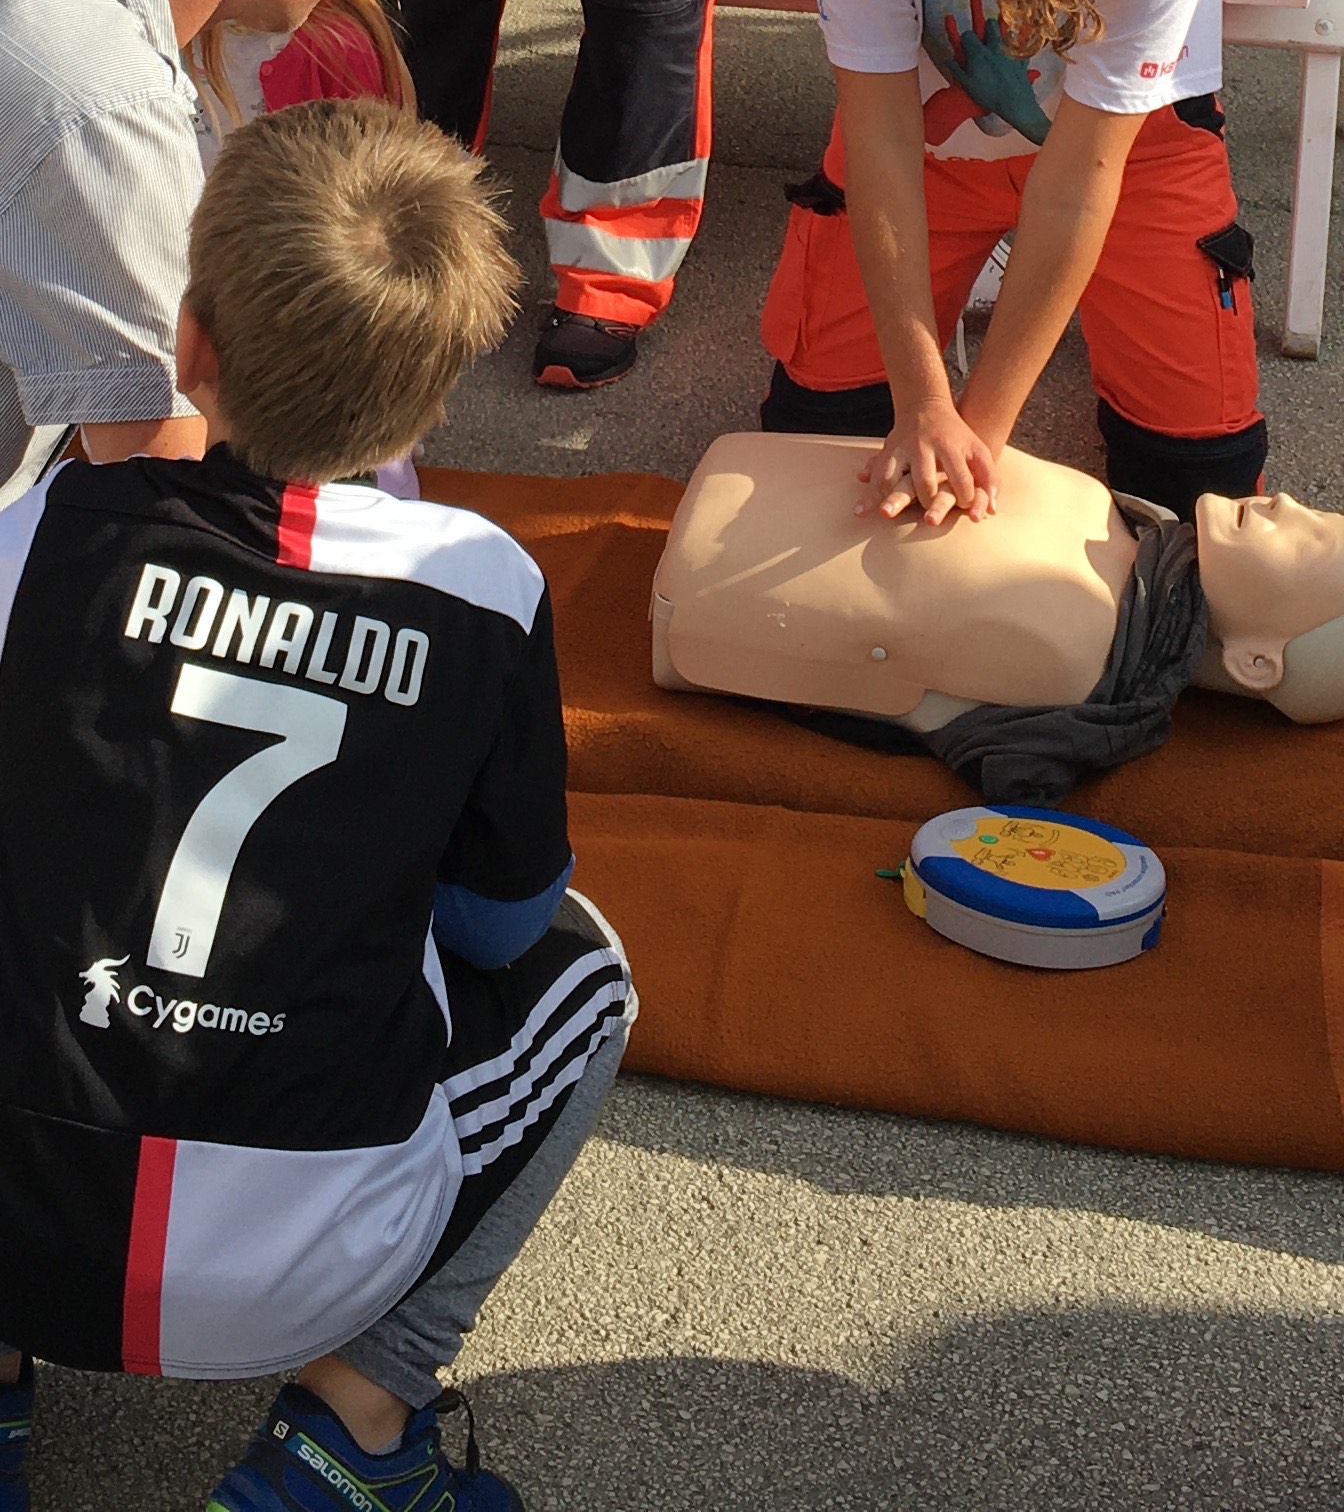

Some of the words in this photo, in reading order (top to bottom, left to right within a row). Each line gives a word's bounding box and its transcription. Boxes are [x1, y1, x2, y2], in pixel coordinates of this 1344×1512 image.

[124, 563, 431, 707] RONALDO
[146, 663, 349, 978] 7
[126, 985, 286, 1036] Cygames
